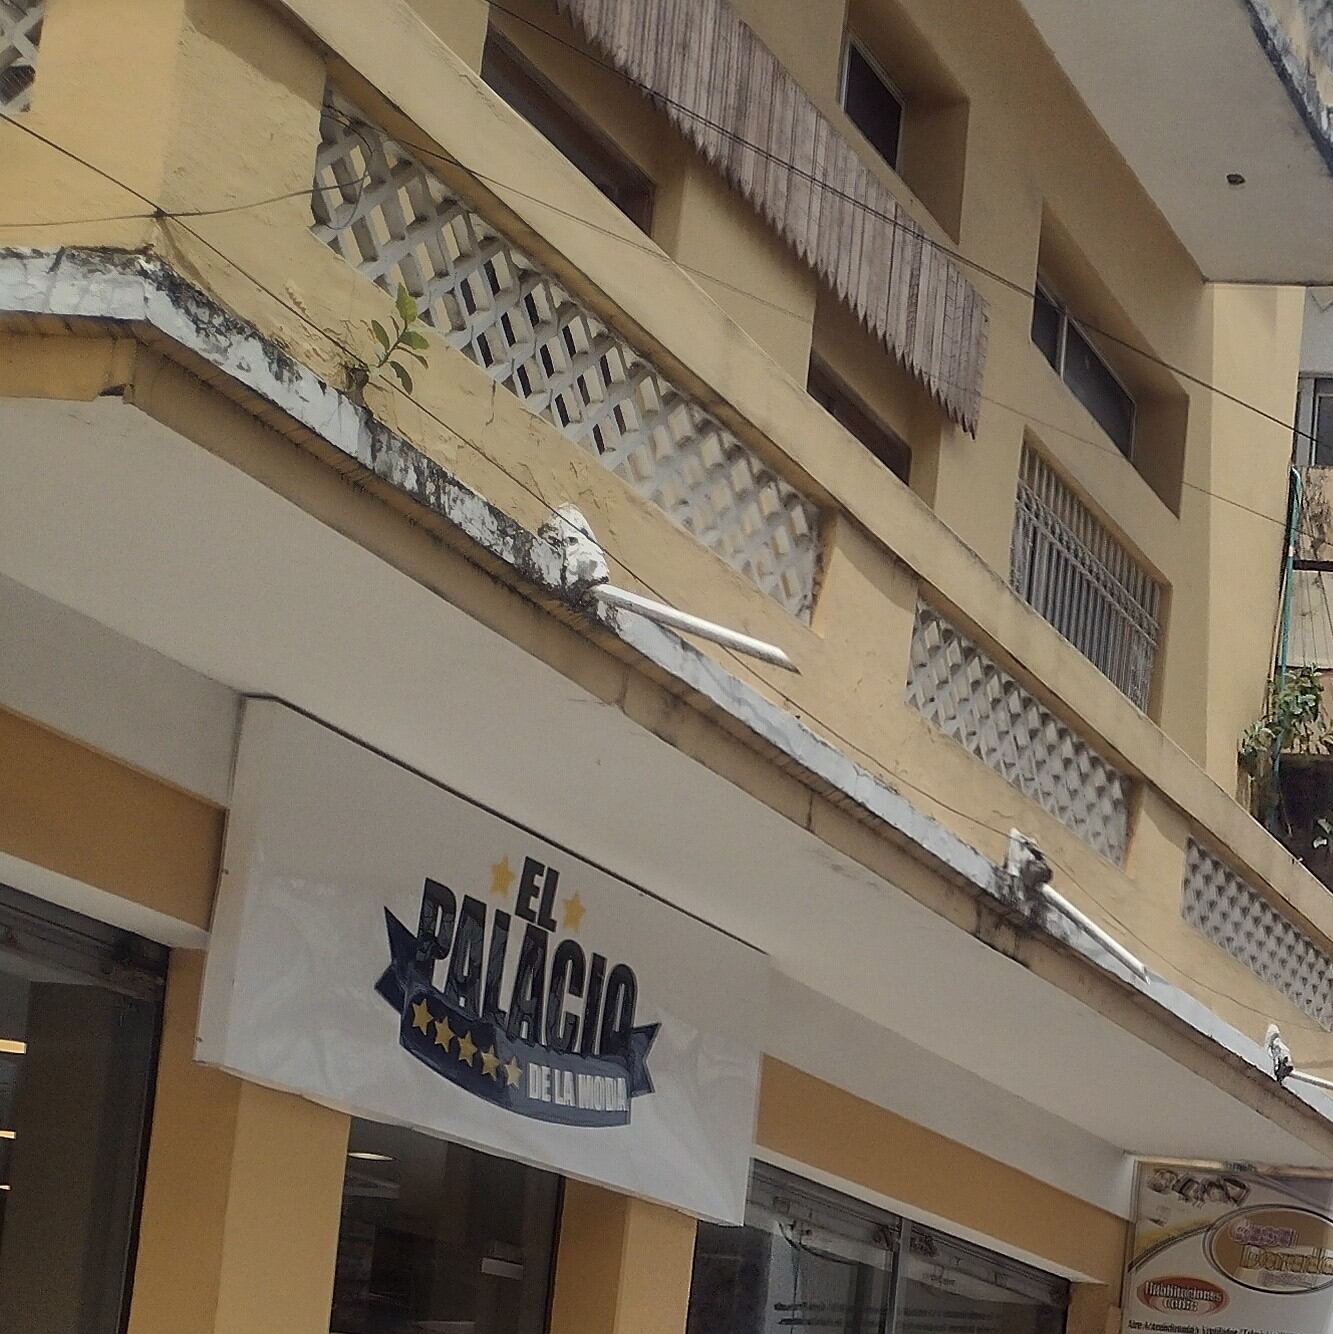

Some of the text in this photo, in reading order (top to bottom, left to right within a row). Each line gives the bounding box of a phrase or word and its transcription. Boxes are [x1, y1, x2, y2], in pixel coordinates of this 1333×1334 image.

[515, 856, 560, 932] EL
[413, 877, 638, 1057] PALACIO
[529, 1062, 629, 1112] DE LA MODA
